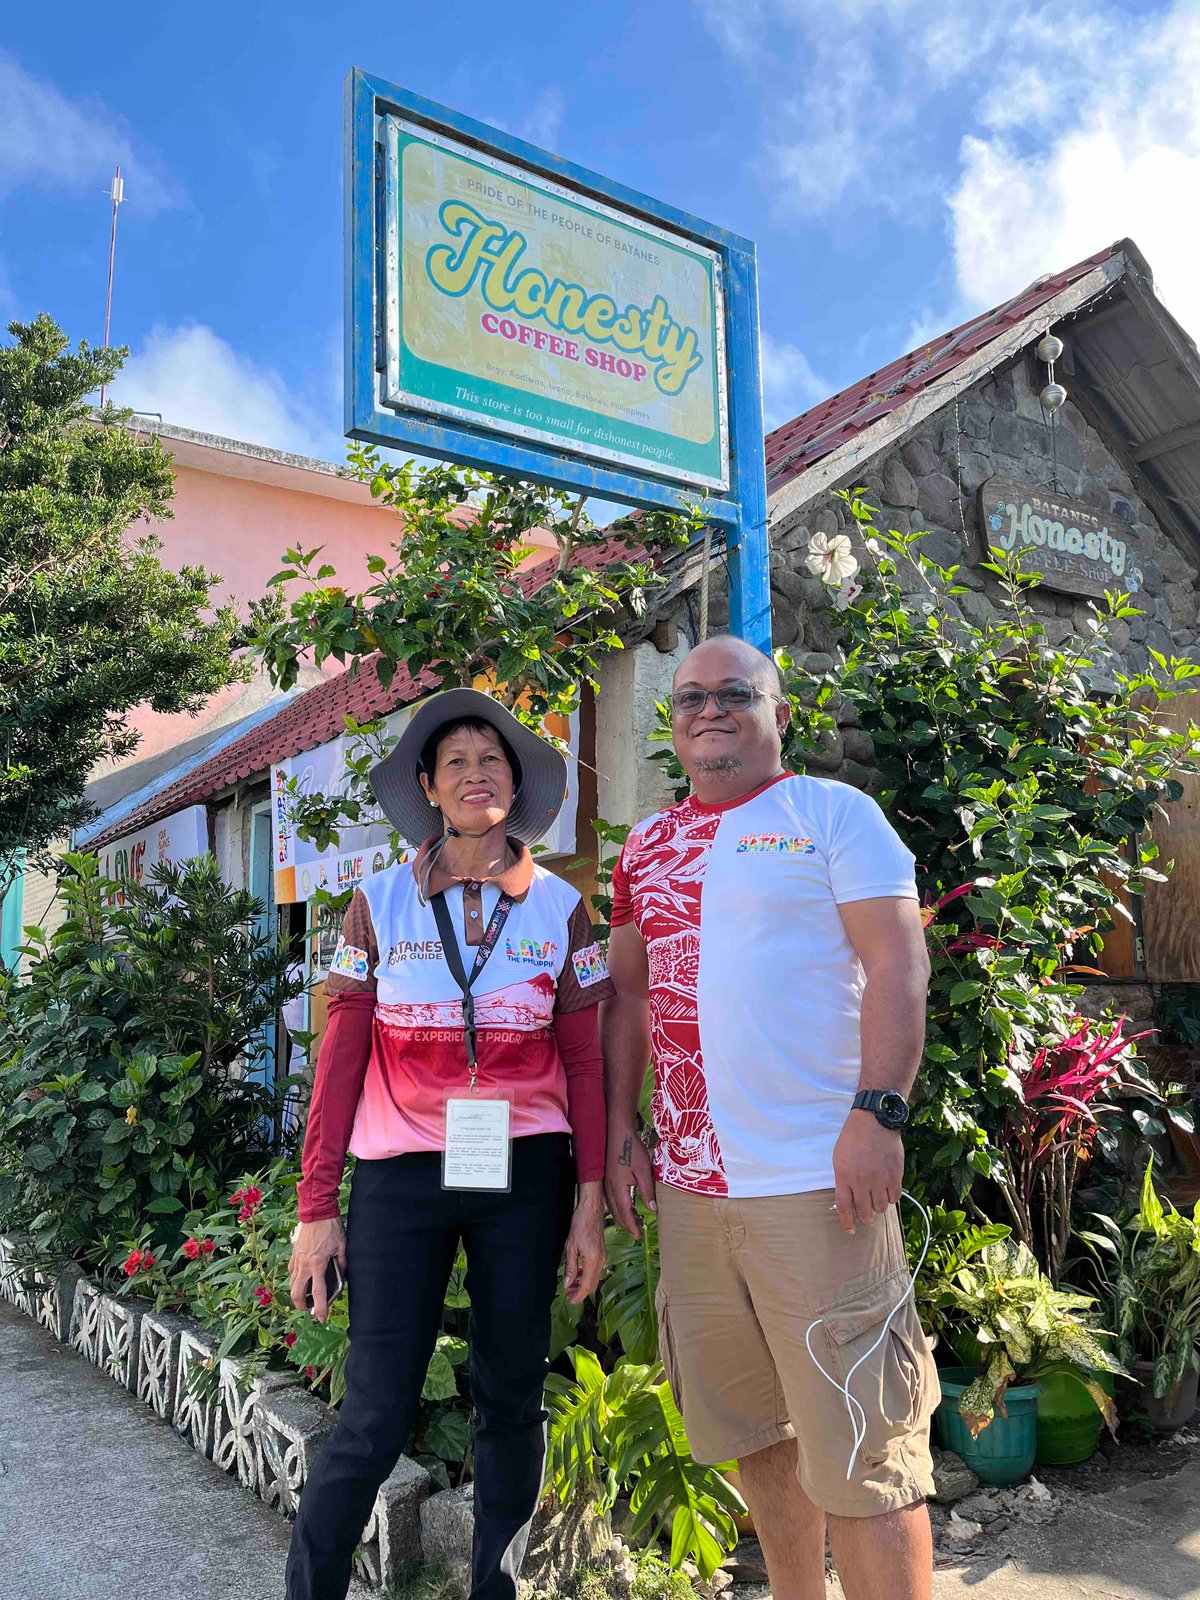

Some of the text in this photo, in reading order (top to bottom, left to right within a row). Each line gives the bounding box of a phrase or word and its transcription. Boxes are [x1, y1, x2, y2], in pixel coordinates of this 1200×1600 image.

[467, 178, 660, 265] PRIDE OF THE PEOPLE OF BATANES
[425, 199, 702, 397] Honesty
[481, 313, 647, 382] COFFEE SHOP
[455, 386, 676, 461] This store is too small for dishonest people.
[1031, 497, 1099, 528] BATANES
[1000, 503, 1127, 577] Honesty
[337, 857, 363, 882] LOVE
[736, 837, 816, 854] BATANES
[410, 952, 443, 960] GUIDE
[507, 955, 520, 964] THE
